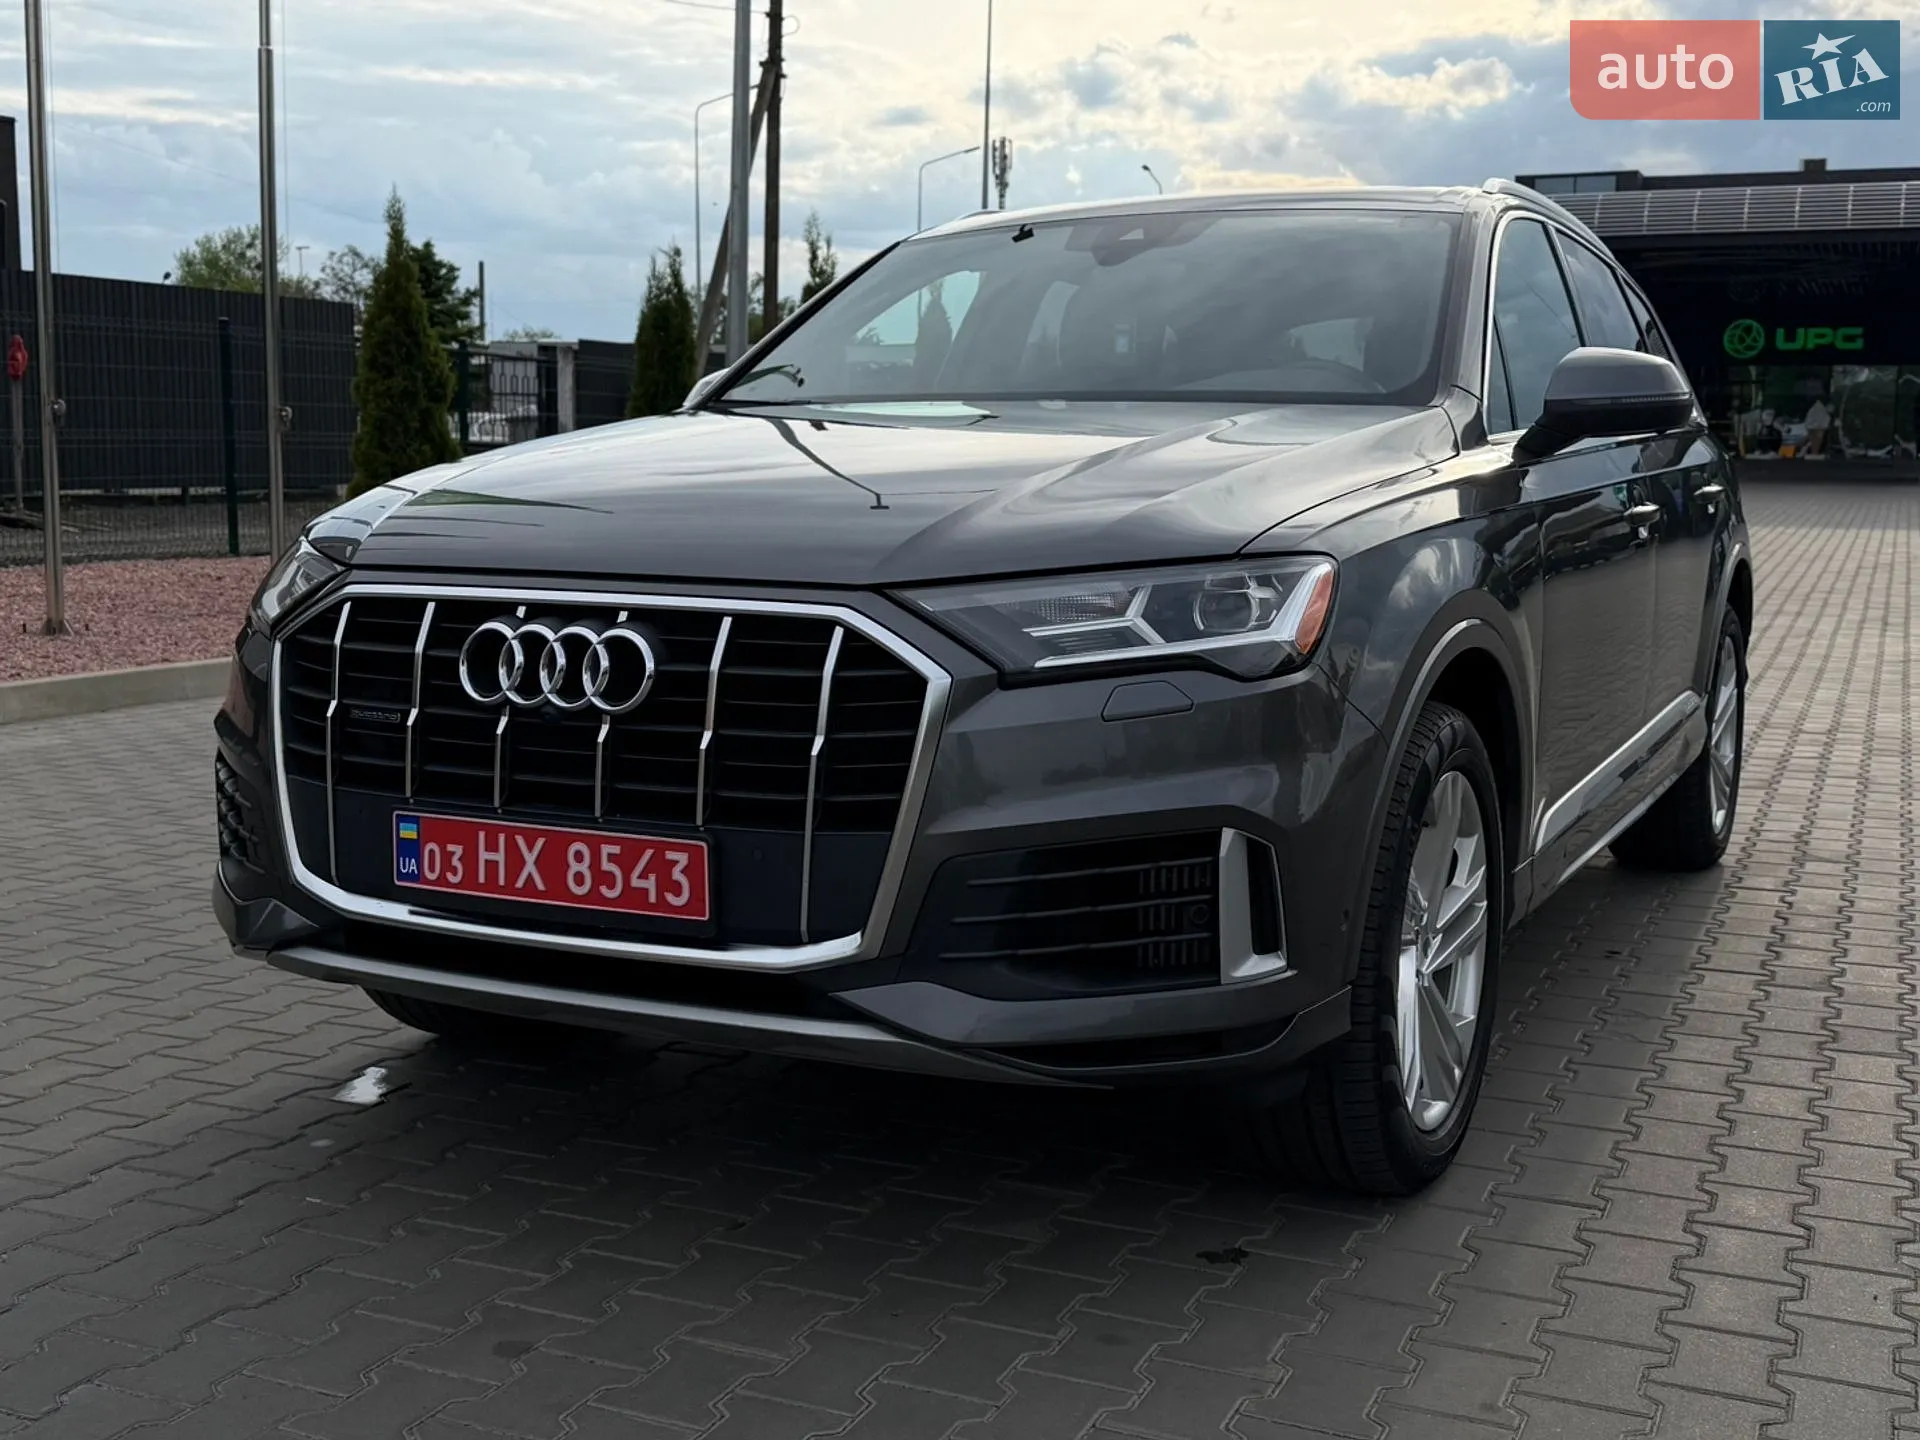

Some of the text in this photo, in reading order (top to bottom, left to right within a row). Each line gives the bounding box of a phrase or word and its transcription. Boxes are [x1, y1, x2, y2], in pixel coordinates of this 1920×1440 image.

[1775, 327, 1864, 350] UPG
[399, 857, 418, 876] UA
[423, 830, 691, 907] 03 HX 8543
